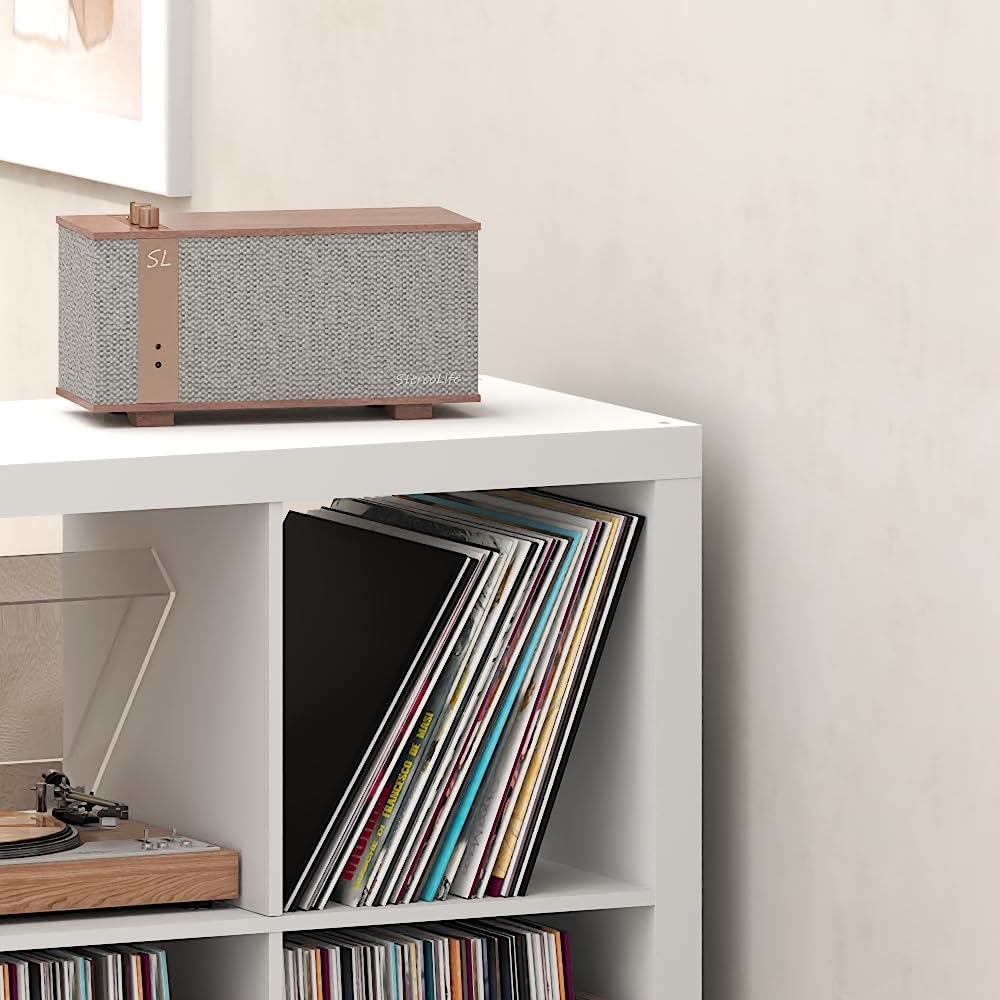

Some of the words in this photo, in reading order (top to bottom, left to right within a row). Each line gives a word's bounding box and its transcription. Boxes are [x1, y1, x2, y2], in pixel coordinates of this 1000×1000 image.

[146, 248, 172, 269] SL
[381, 759, 413, 818] FRANCESCO
[408, 742, 422, 757] DE
[415, 711, 434, 740] MASI
